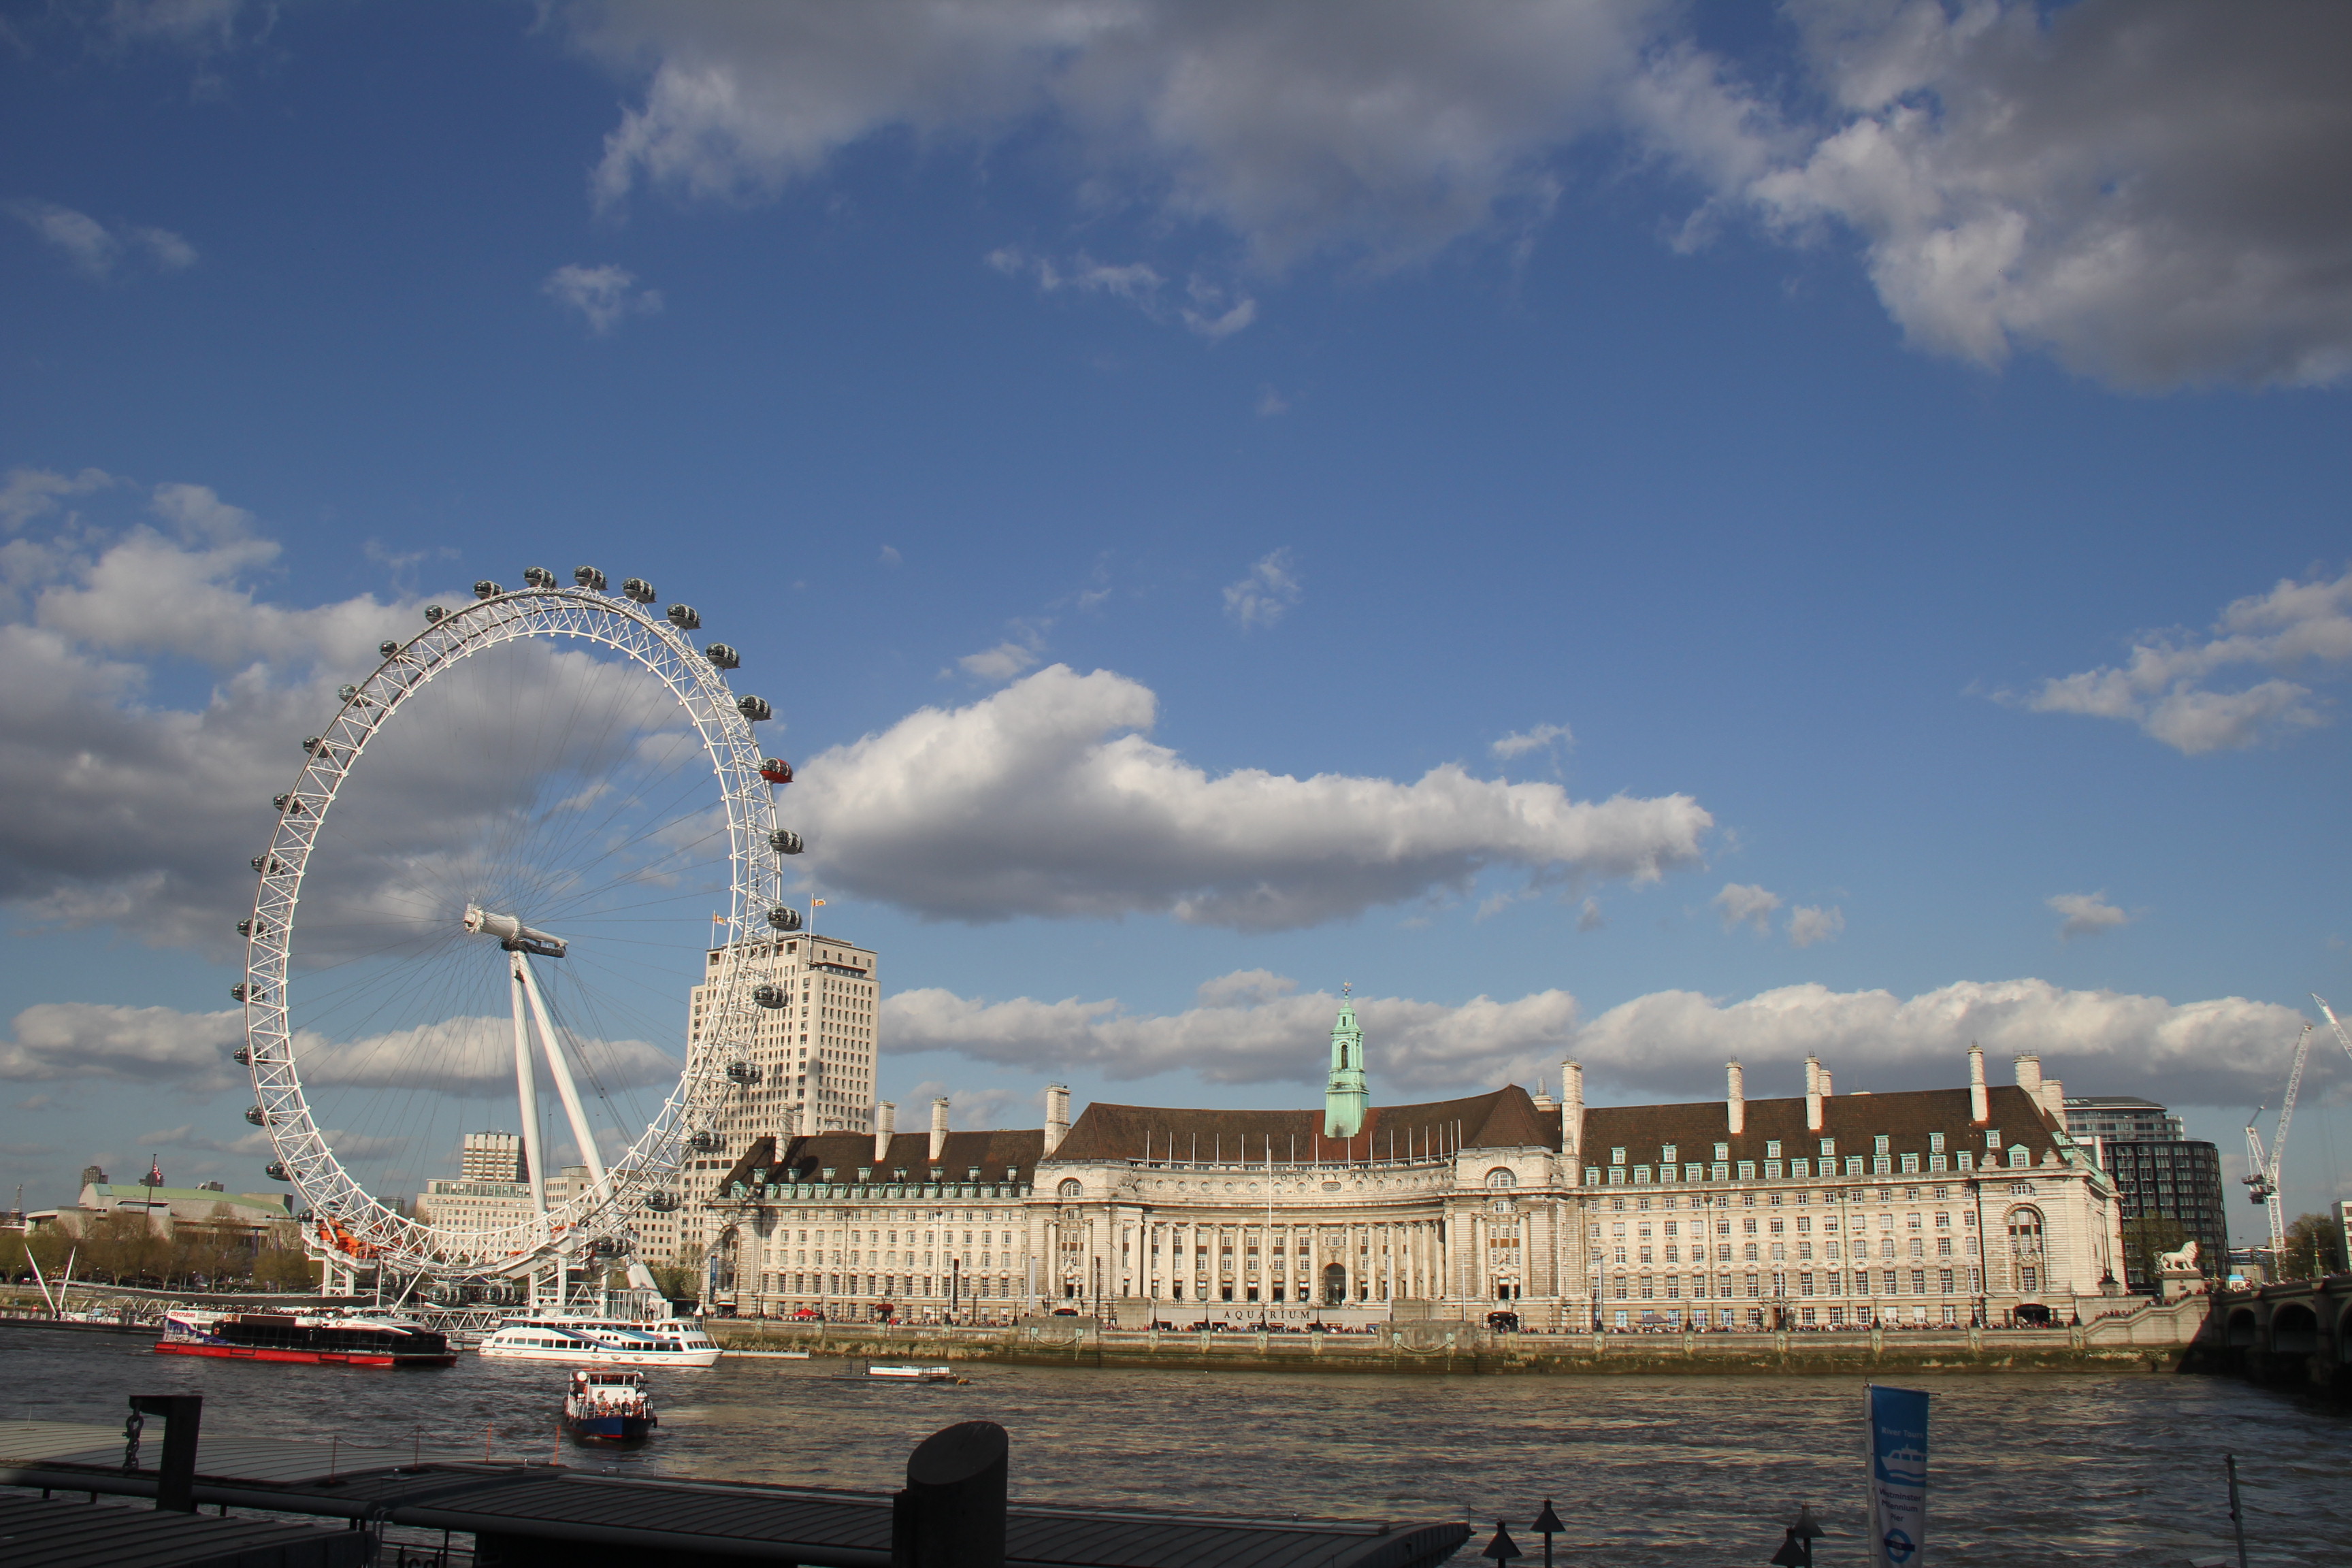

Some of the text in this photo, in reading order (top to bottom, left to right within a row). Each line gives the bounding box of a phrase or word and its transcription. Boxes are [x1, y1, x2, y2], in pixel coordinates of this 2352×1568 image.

[1268, 1171, 1389, 1181] COUNTY HALL
[1224, 1310, 1310, 1320] AQUARIUM
[1881, 1426, 1924, 1439] River Tours
[1890, 1513, 1904, 1522] Pier
